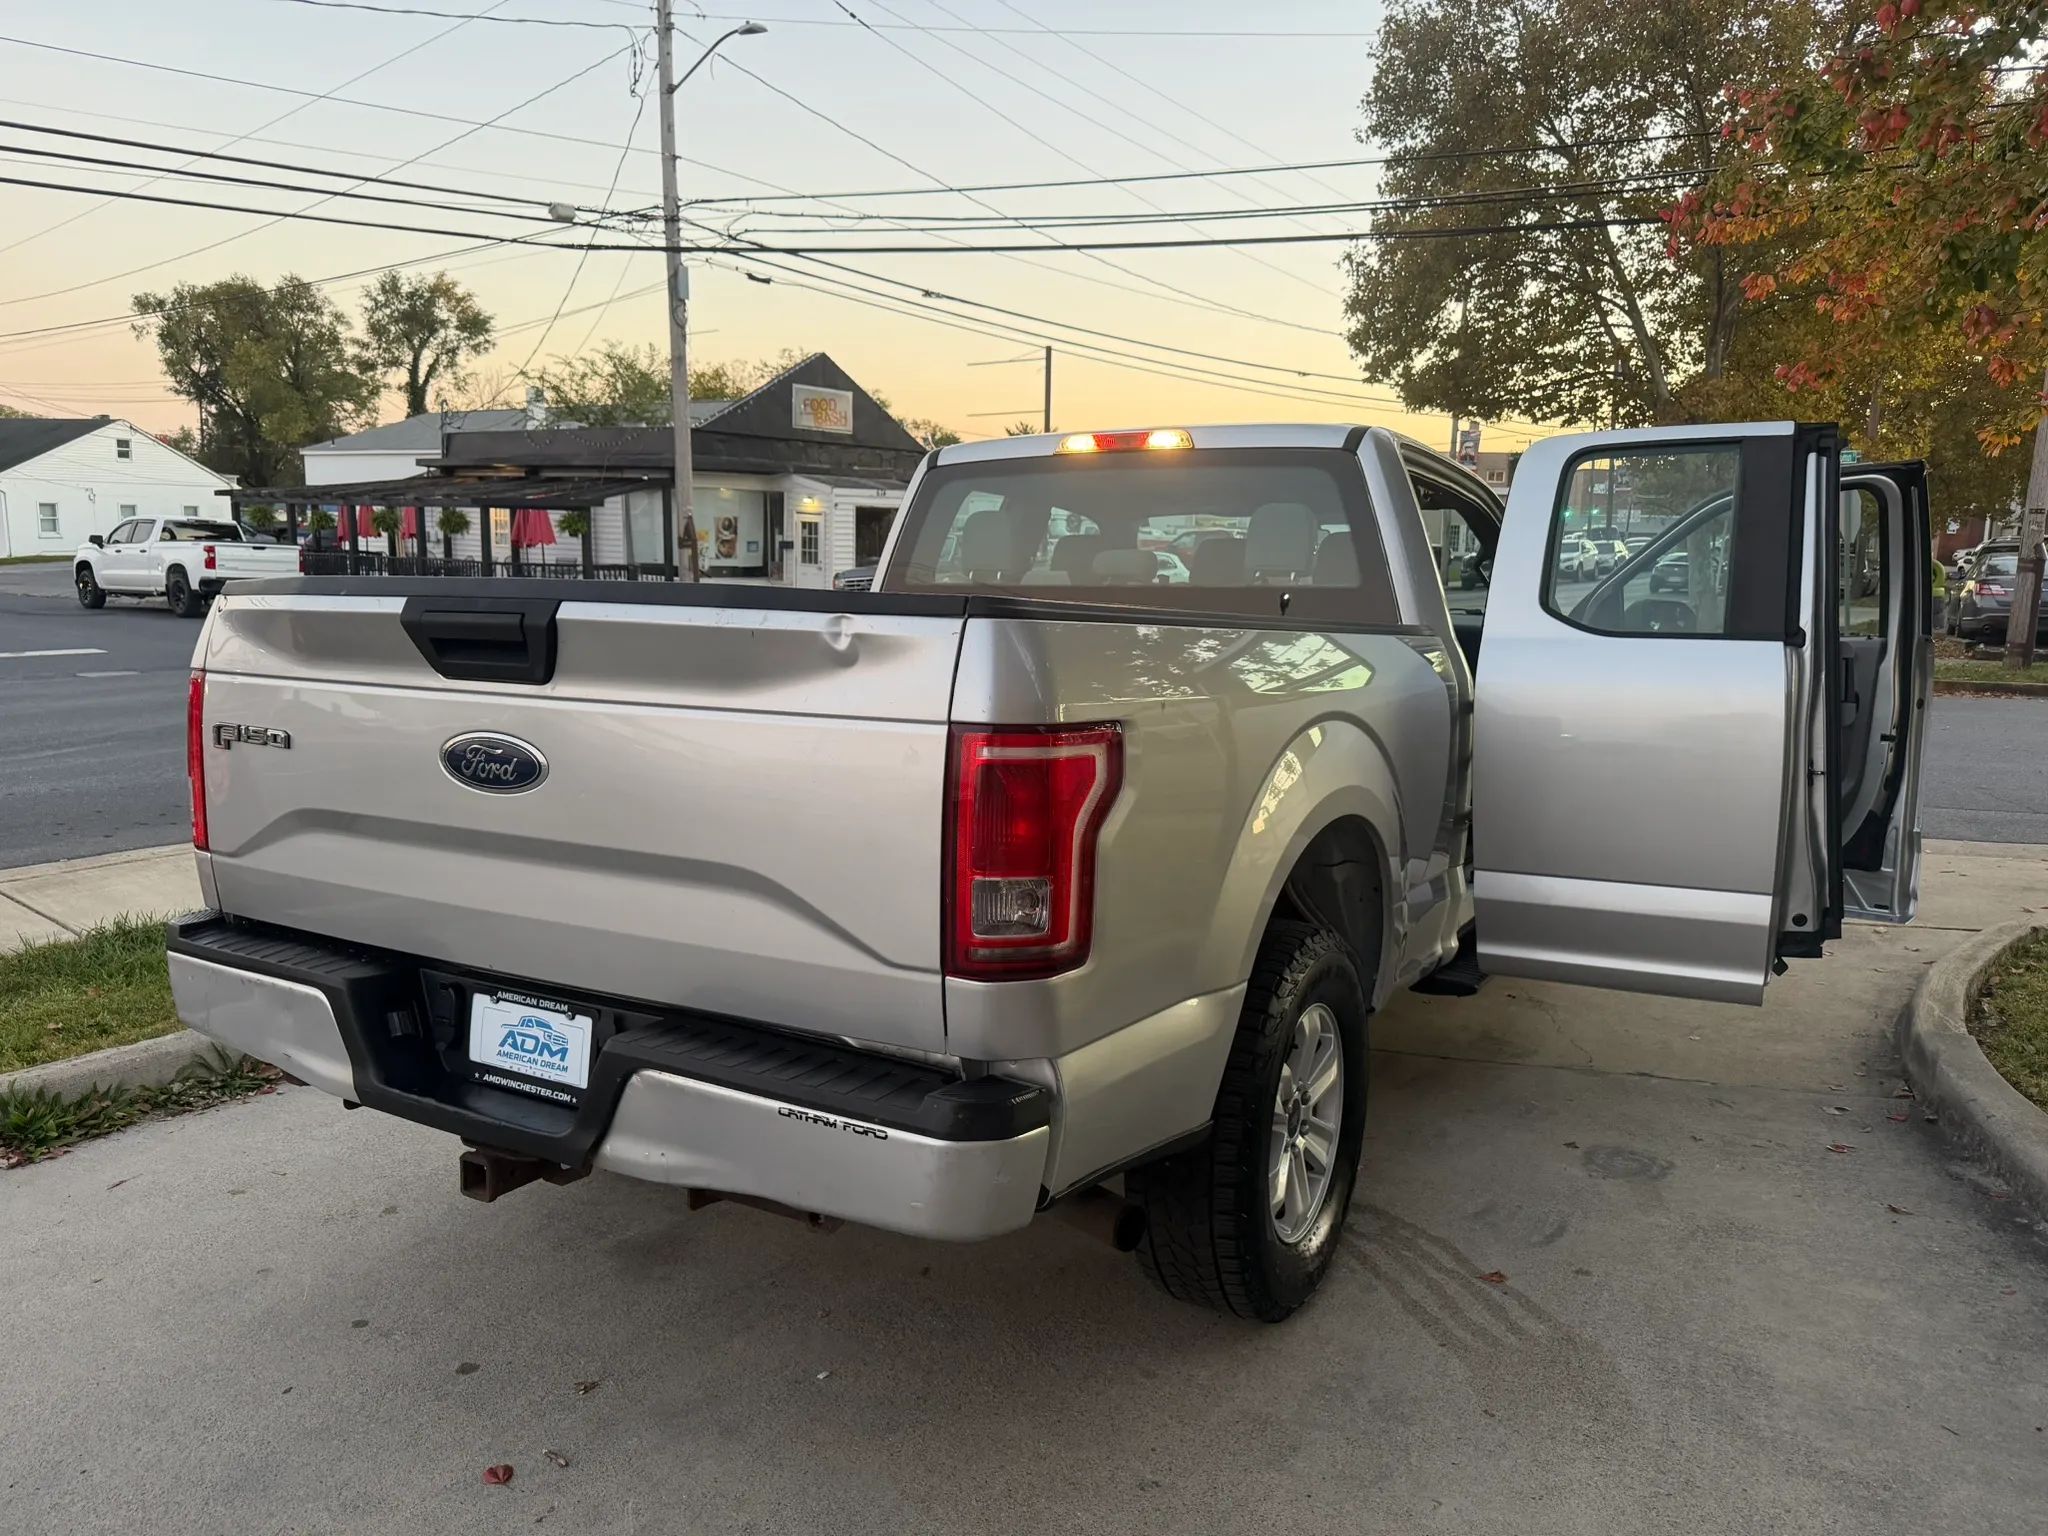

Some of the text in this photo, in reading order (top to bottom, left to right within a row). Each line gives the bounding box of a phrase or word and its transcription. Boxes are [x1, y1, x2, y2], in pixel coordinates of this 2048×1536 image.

[803, 398, 838, 411] FOOD
[815, 410, 848, 427] BASH
[461, 744, 519, 781] Ford
[496, 991, 569, 1012] AMERICAN DREAM
[498, 1029, 569, 1062] ADM
[496, 1049, 569, 1073] AMERICAN DREAM
[840, 1121, 889, 1141] FORD
